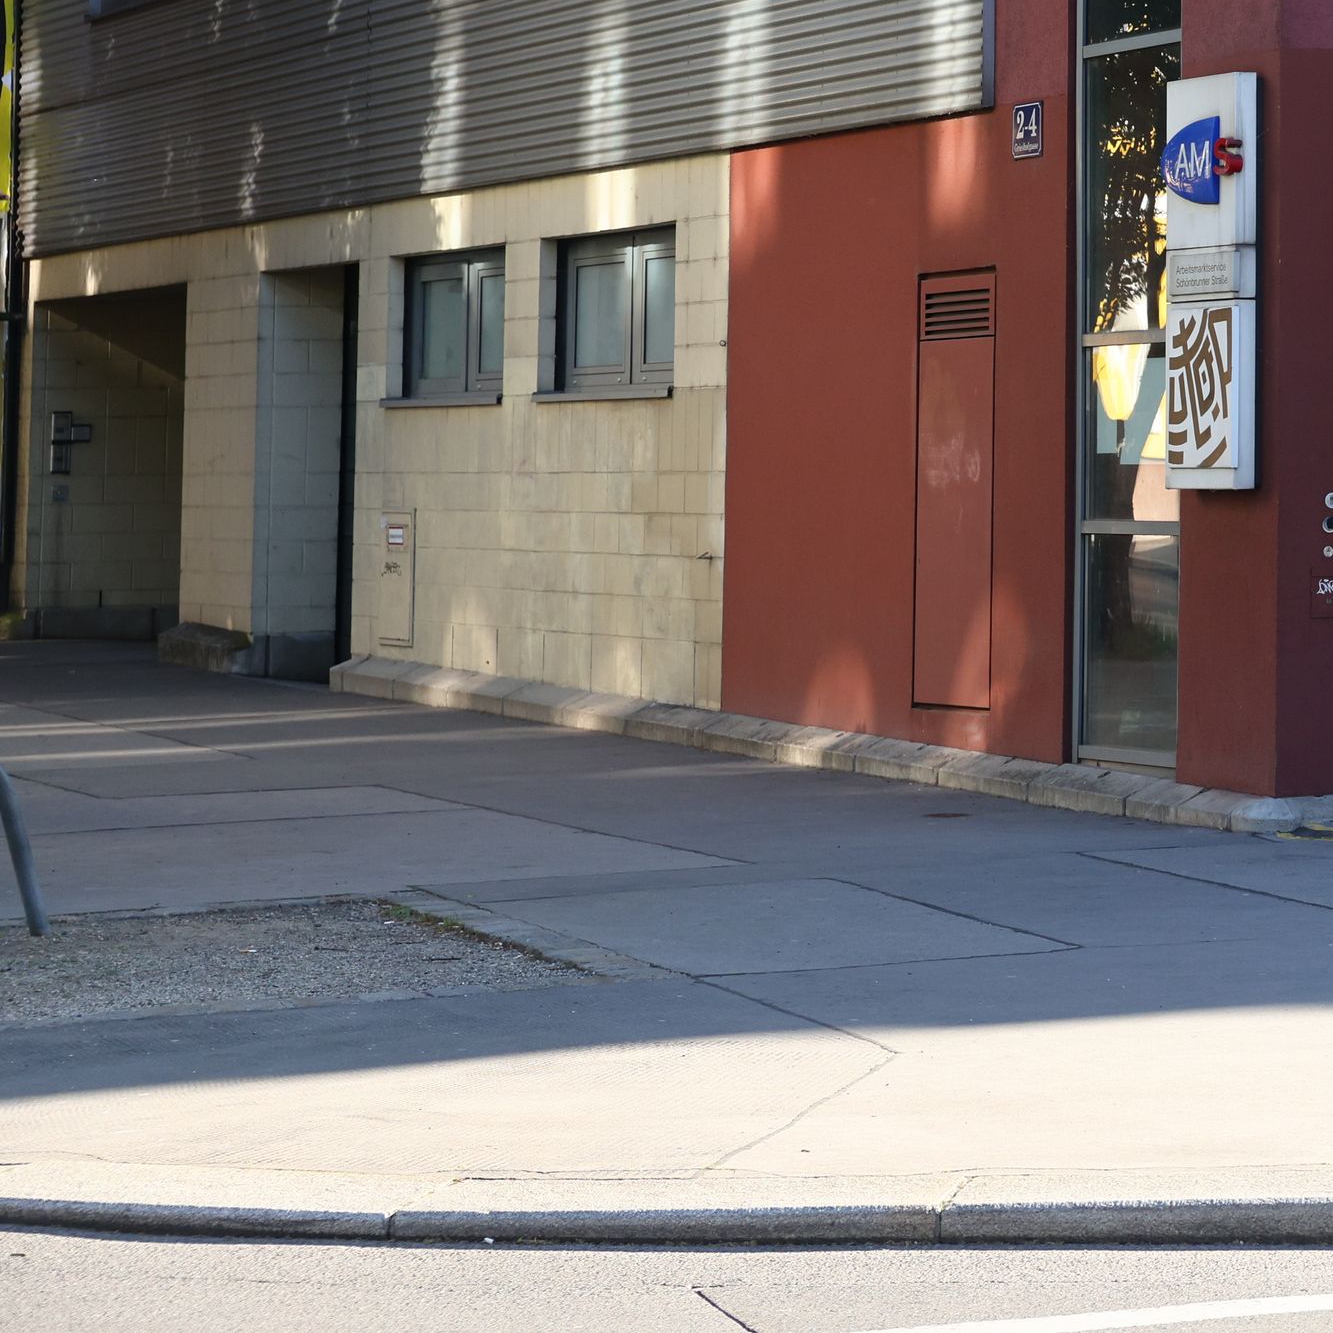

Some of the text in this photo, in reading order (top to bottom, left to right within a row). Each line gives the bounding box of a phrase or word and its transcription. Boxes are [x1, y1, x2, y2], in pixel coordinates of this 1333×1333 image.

[1016, 108, 1037, 139] 2-4
[1175, 137, 1243, 180] AMS
[1175, 262, 1227, 275] Arbeitsmarktservice
